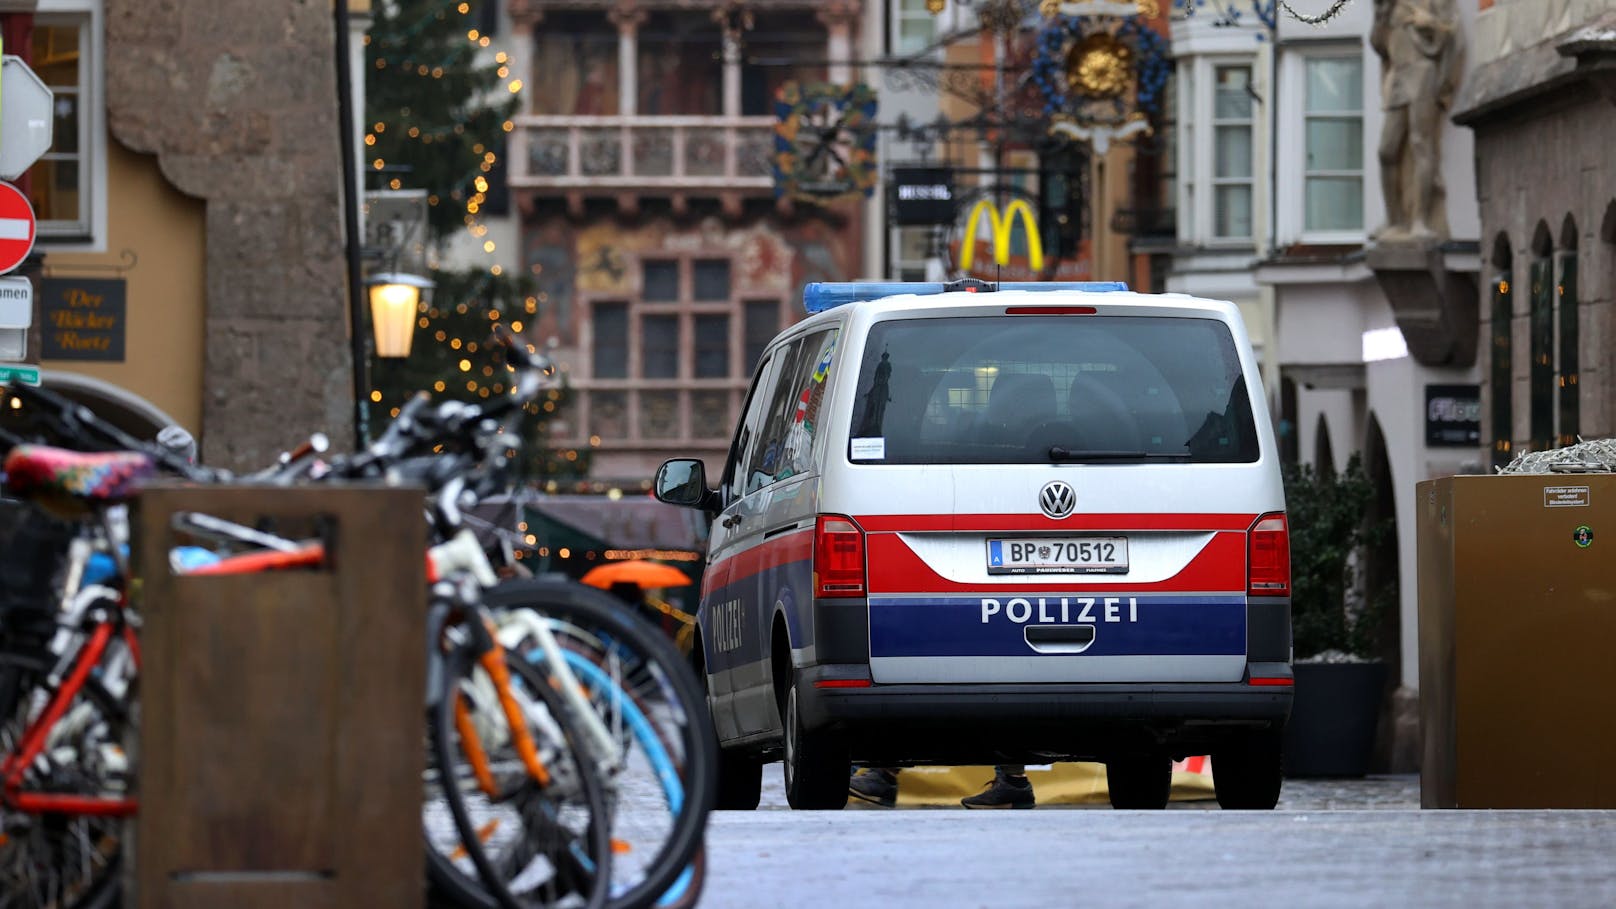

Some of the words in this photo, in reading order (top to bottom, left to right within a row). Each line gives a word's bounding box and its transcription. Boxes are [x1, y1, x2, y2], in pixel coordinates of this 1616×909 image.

[1011, 543, 1036, 562] BP
[1053, 543, 1115, 562] 70512
[981, 598, 1138, 624] POLIZEI
[712, 598, 742, 653] POLIZEI
